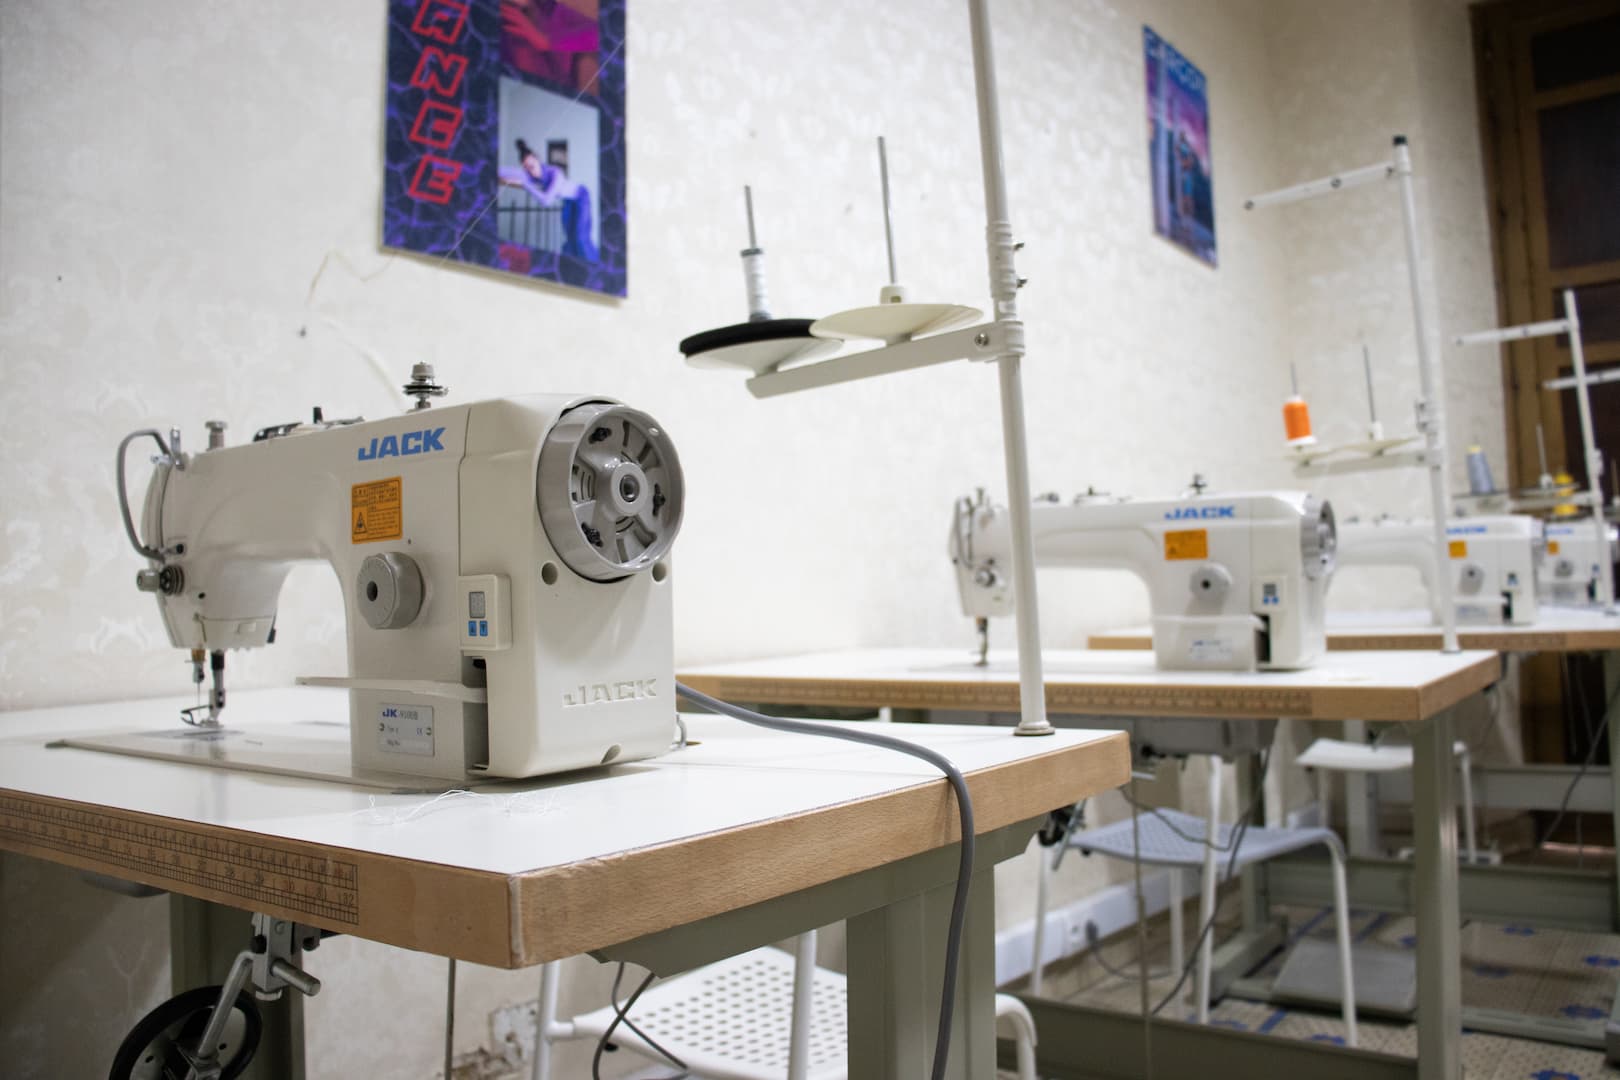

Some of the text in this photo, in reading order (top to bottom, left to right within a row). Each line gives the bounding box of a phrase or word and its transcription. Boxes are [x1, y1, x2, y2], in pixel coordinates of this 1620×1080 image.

[358, 427, 446, 461] JACK
[1164, 506, 1235, 520] JACK
[563, 679, 656, 707] JACK
